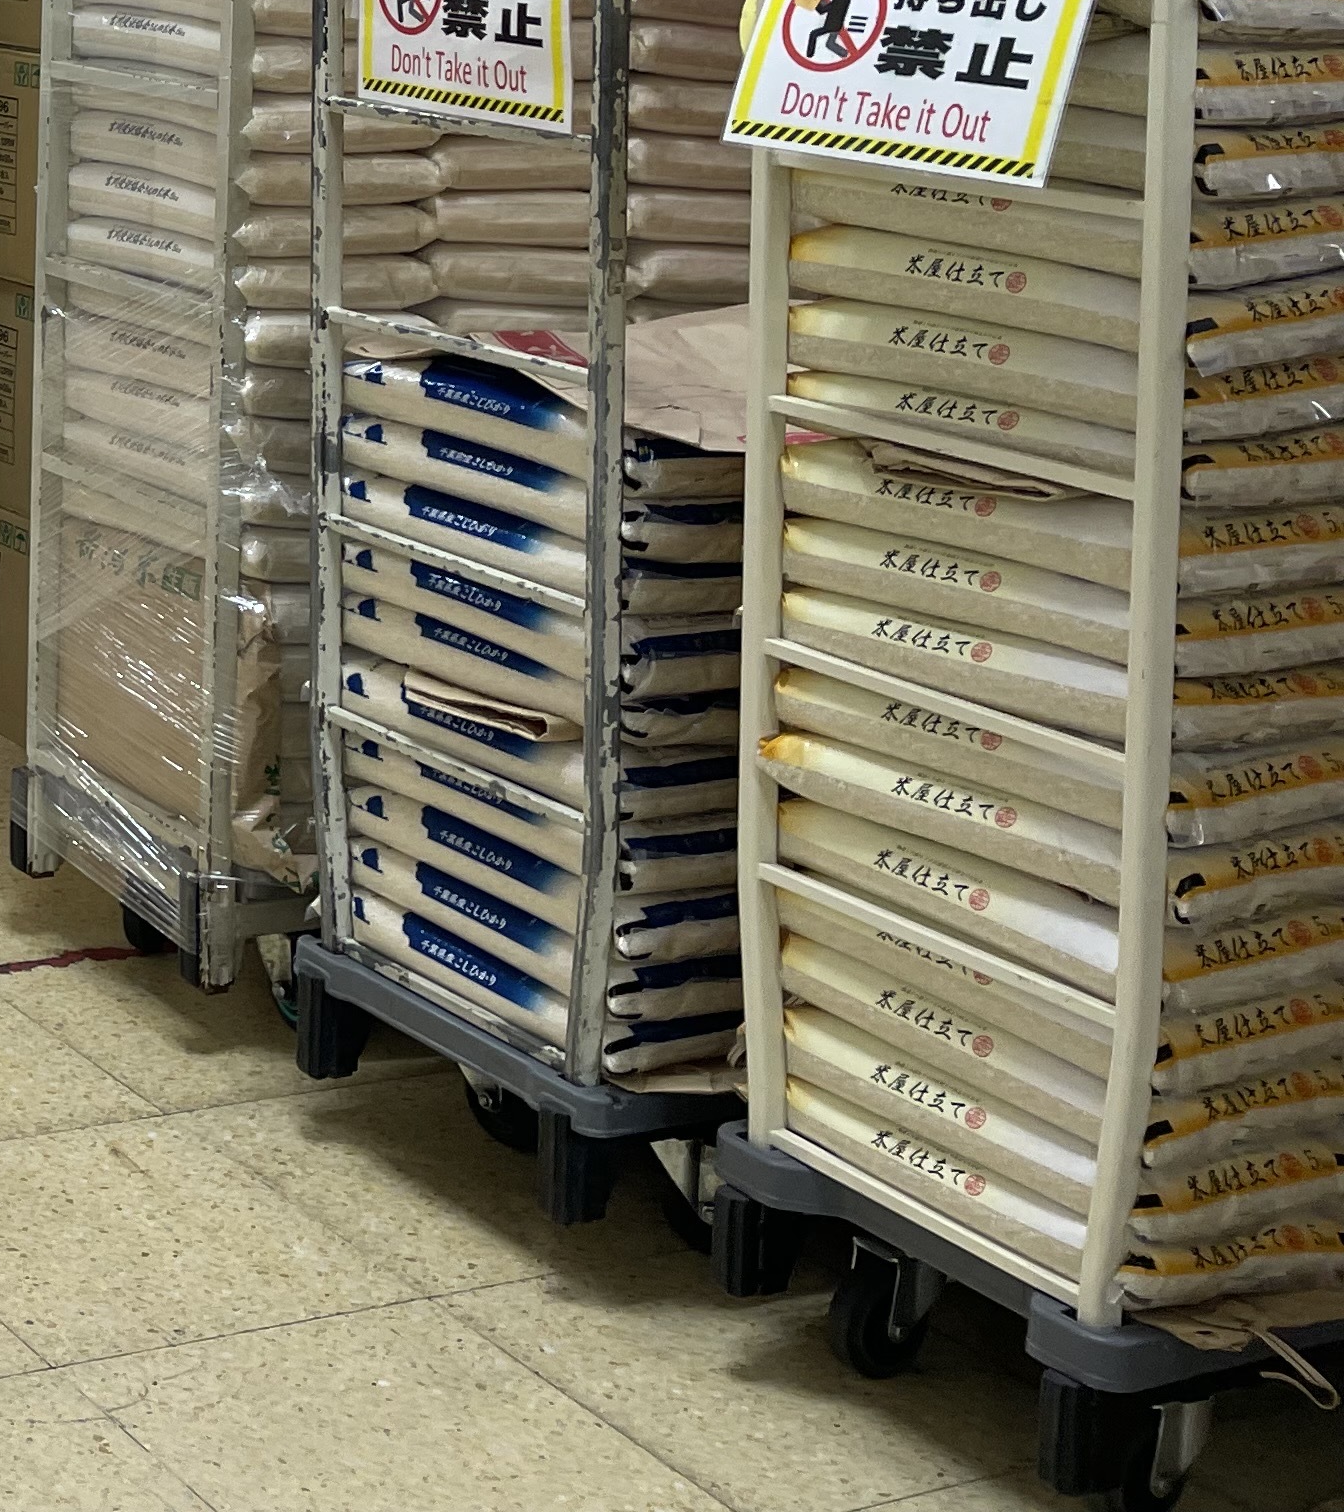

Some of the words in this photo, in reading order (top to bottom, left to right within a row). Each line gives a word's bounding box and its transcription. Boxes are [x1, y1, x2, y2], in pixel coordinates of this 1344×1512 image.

[391, 44, 432, 79] Don't
[436, 51, 472, 86] Take
[477, 56, 490, 88] it
[494, 59, 528, 94] Out
[873, 26, 1034, 91] 禁止
[1235, 54, 1325, 81] 米屋仕立て
[780, 82, 849, 122] Don't
[853, 90, 910, 131] Take
[916, 97, 937, 133] it
[941, 101, 992, 144] Out
[1222, 208, 1322, 241] 米屋仕立て
[903, 253, 1005, 288] 米屋仕立て
[887, 324, 990, 361] 米屋仕立て
[895, 391, 998, 428] 米屋仕立て
[874, 476, 977, 512] 米屋仕立て
[1202, 519, 1300, 549] 米屋仕立て
[878, 549, 981, 587] 米屋仕立て
[870, 617, 972, 656] 米屋仕立て
[879, 701, 982, 745] 米屋仕立て
[890, 774, 995, 821] 米屋仕立て
[439, 829, 513, 871] 千葉県産こしひかり
[872, 847, 970, 901] 米屋仕立て
[432, 885, 507, 929] 千葉県産こしひかり
[420, 938, 498, 987] 千葉県産こしひかり
[1194, 926, 1291, 969] 米屋仕立て
[873, 989, 974, 1047] 米屋仕立て
[869, 1063, 967, 1121] 米屋仕立て
[870, 1128, 968, 1186] 米屋仕立て
